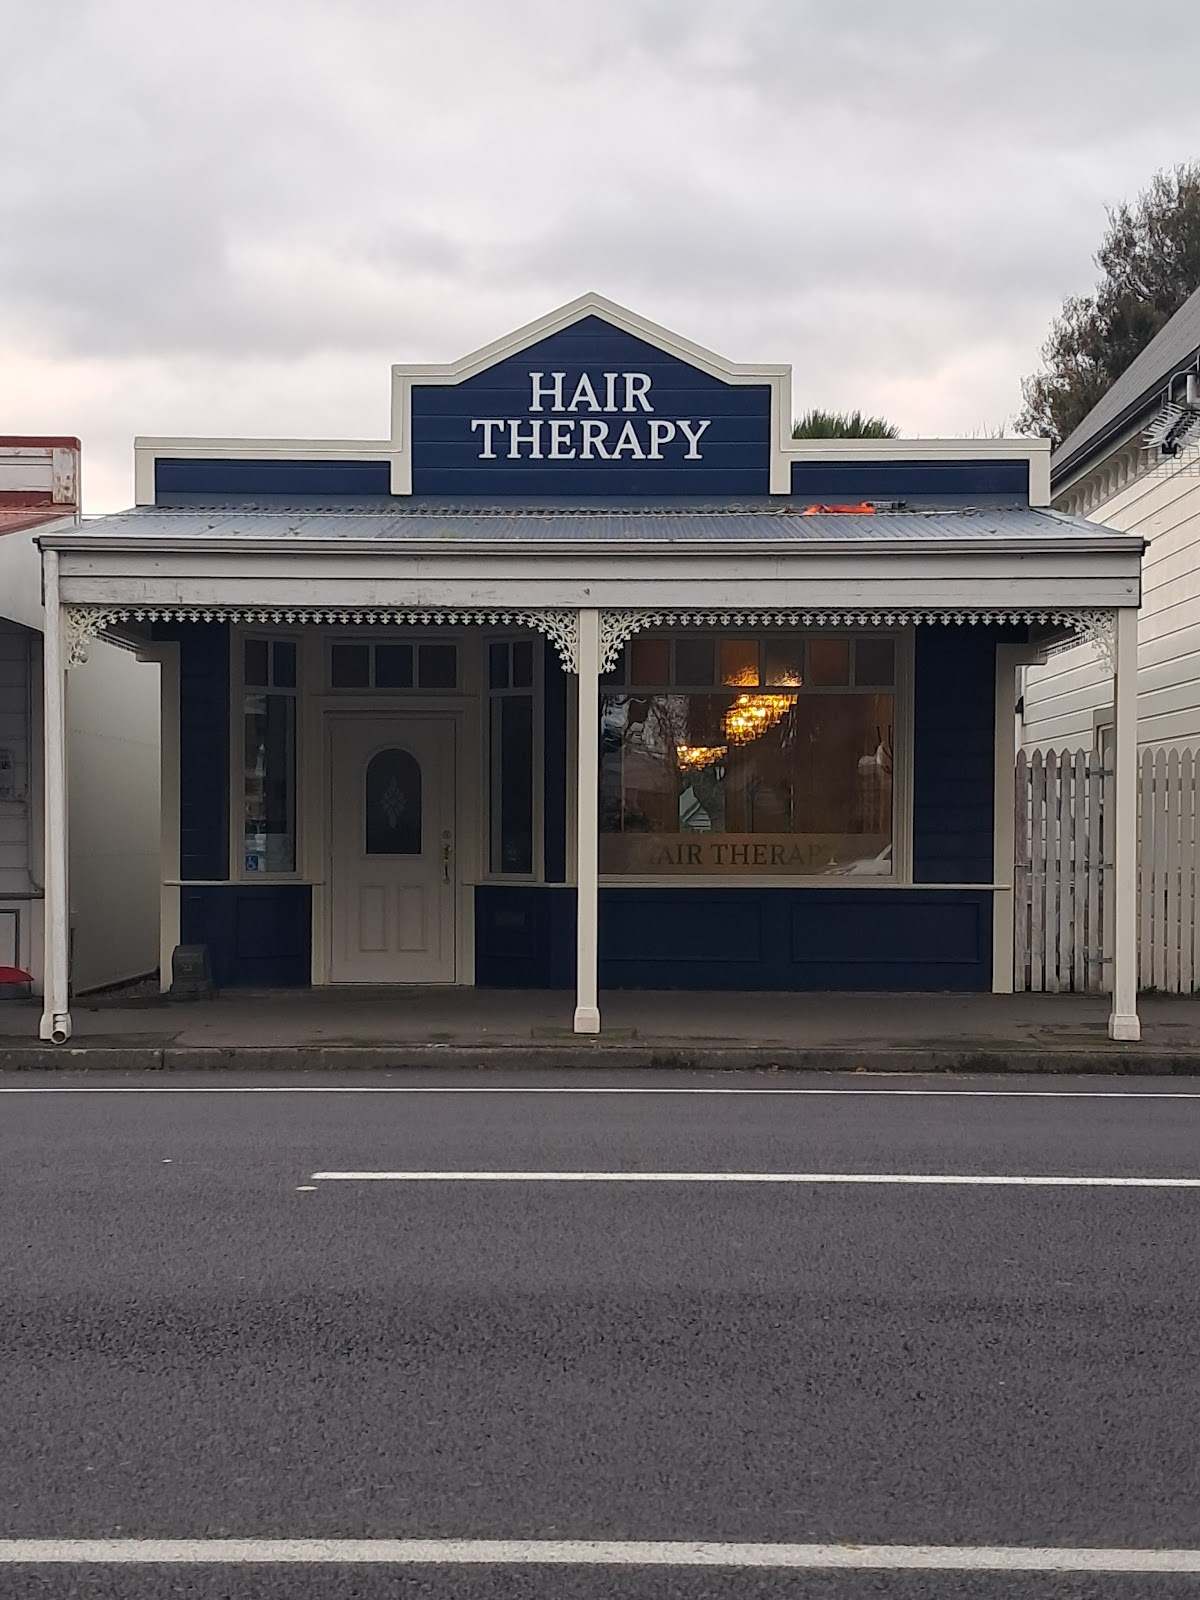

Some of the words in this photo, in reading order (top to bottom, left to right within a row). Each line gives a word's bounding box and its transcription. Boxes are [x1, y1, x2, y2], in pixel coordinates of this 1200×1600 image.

[528, 372, 655, 412] HAIR
[470, 419, 712, 460] THERAPY
[645, 842, 704, 866] AIR
[709, 842, 832, 866] THERAP
